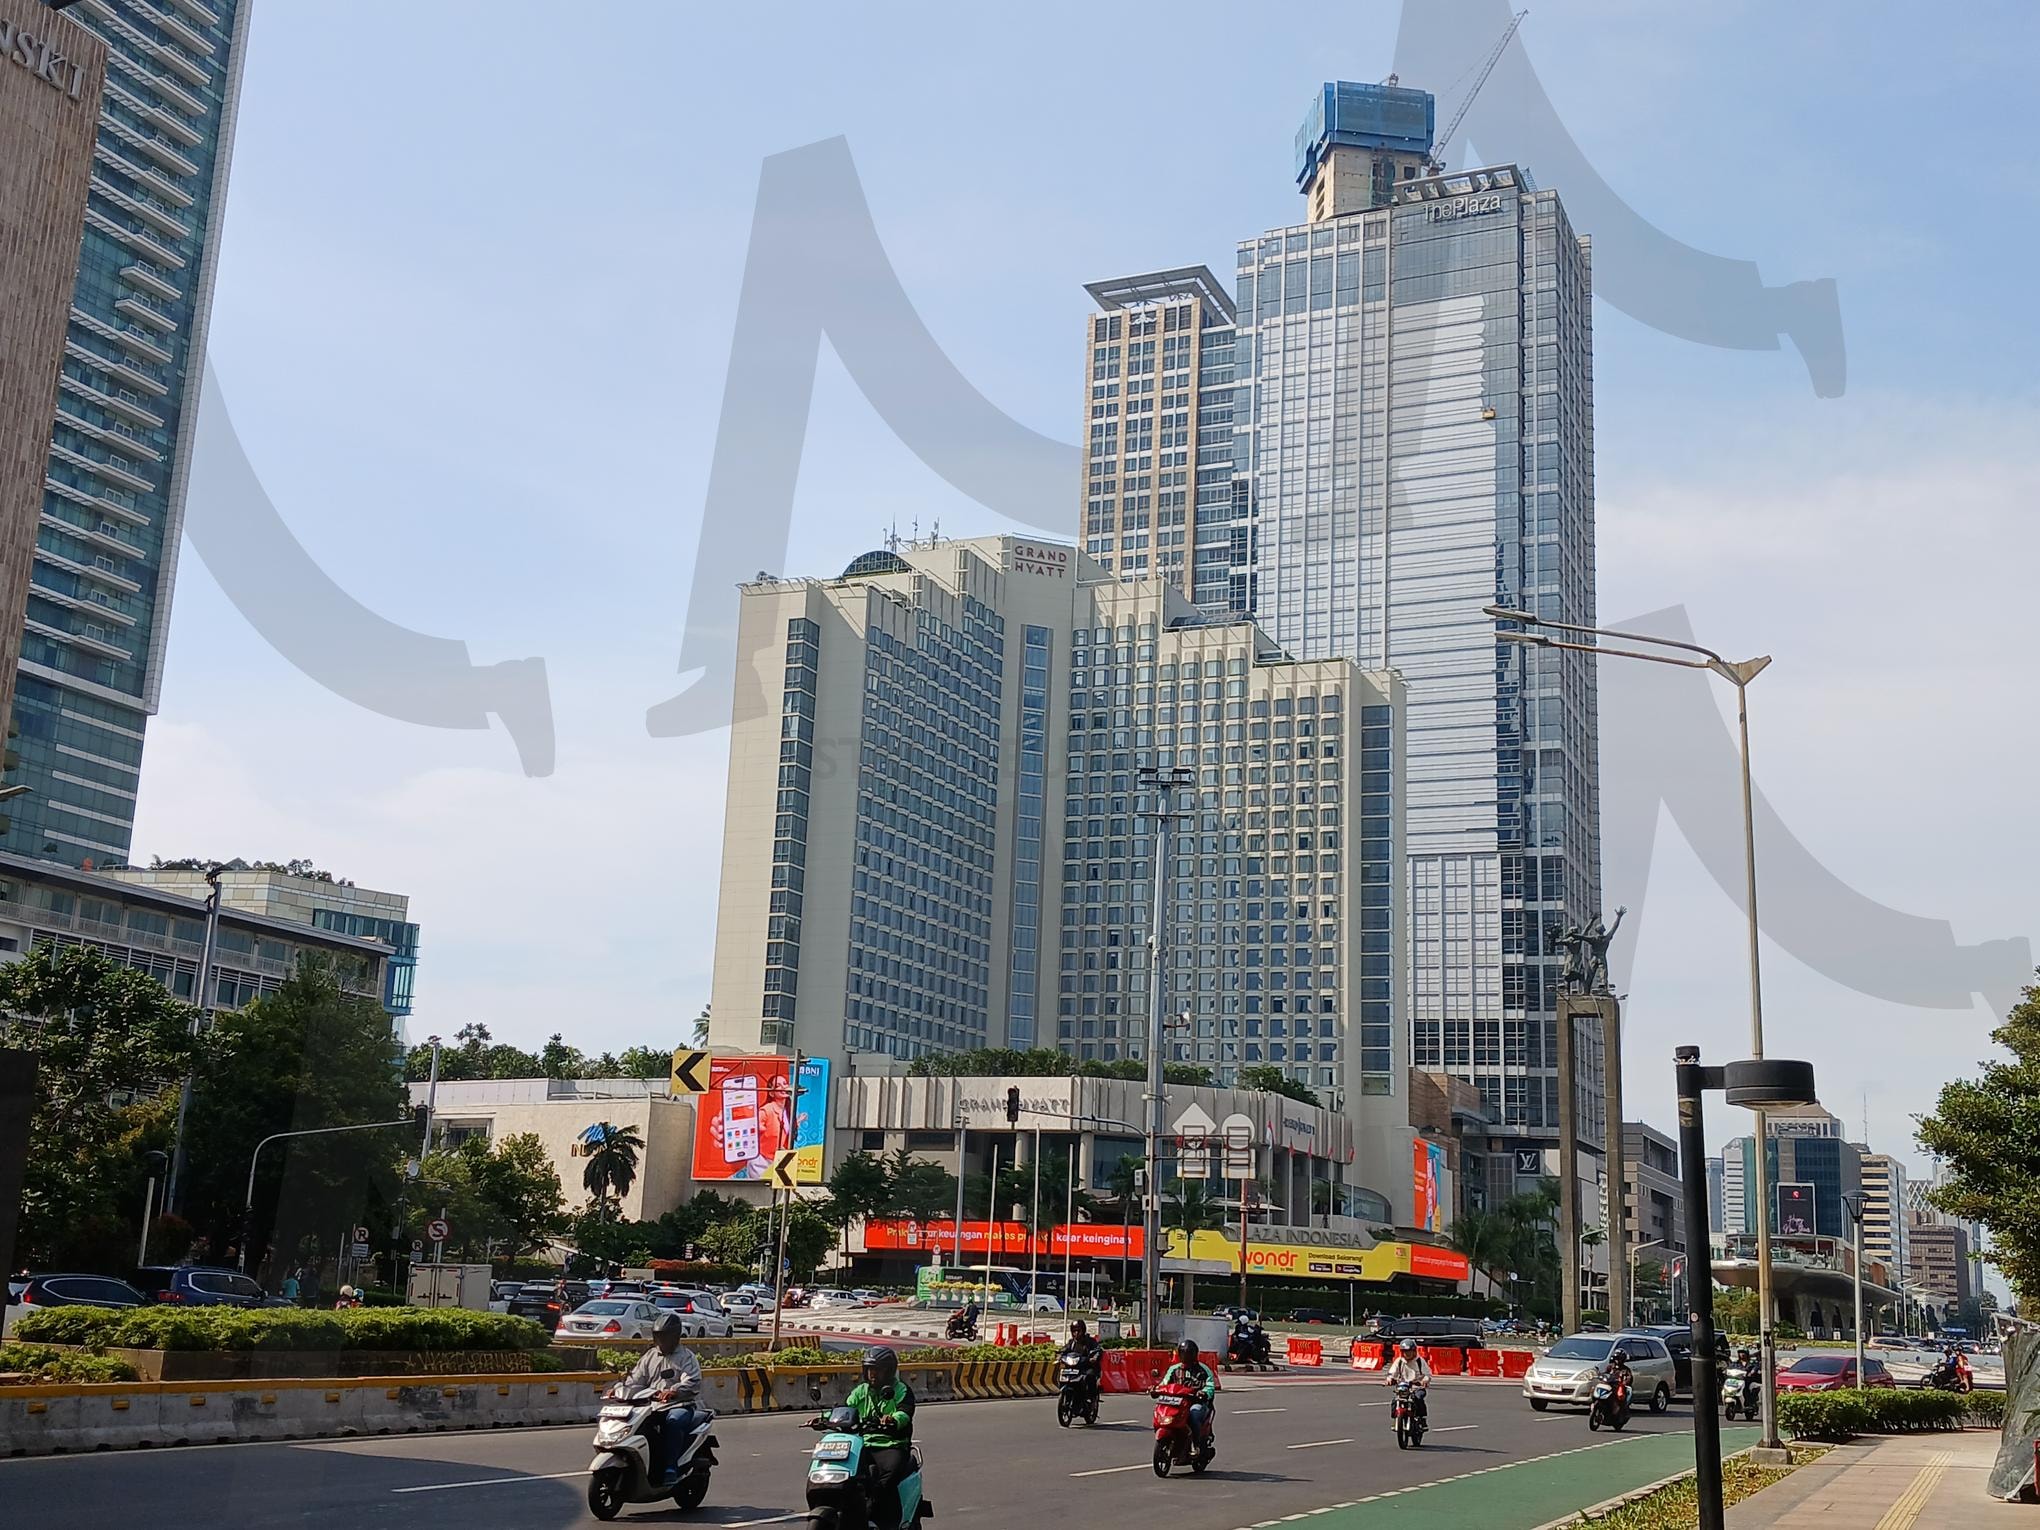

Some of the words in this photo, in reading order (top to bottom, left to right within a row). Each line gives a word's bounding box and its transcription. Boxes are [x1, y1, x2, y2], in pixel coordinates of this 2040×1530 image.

[1014, 545, 1067, 562] GRAND
[1014, 561, 1065, 578] HYATT
[1286, 1229, 1362, 1247] INDONESIA
[1308, 1252, 1335, 1260] Download
